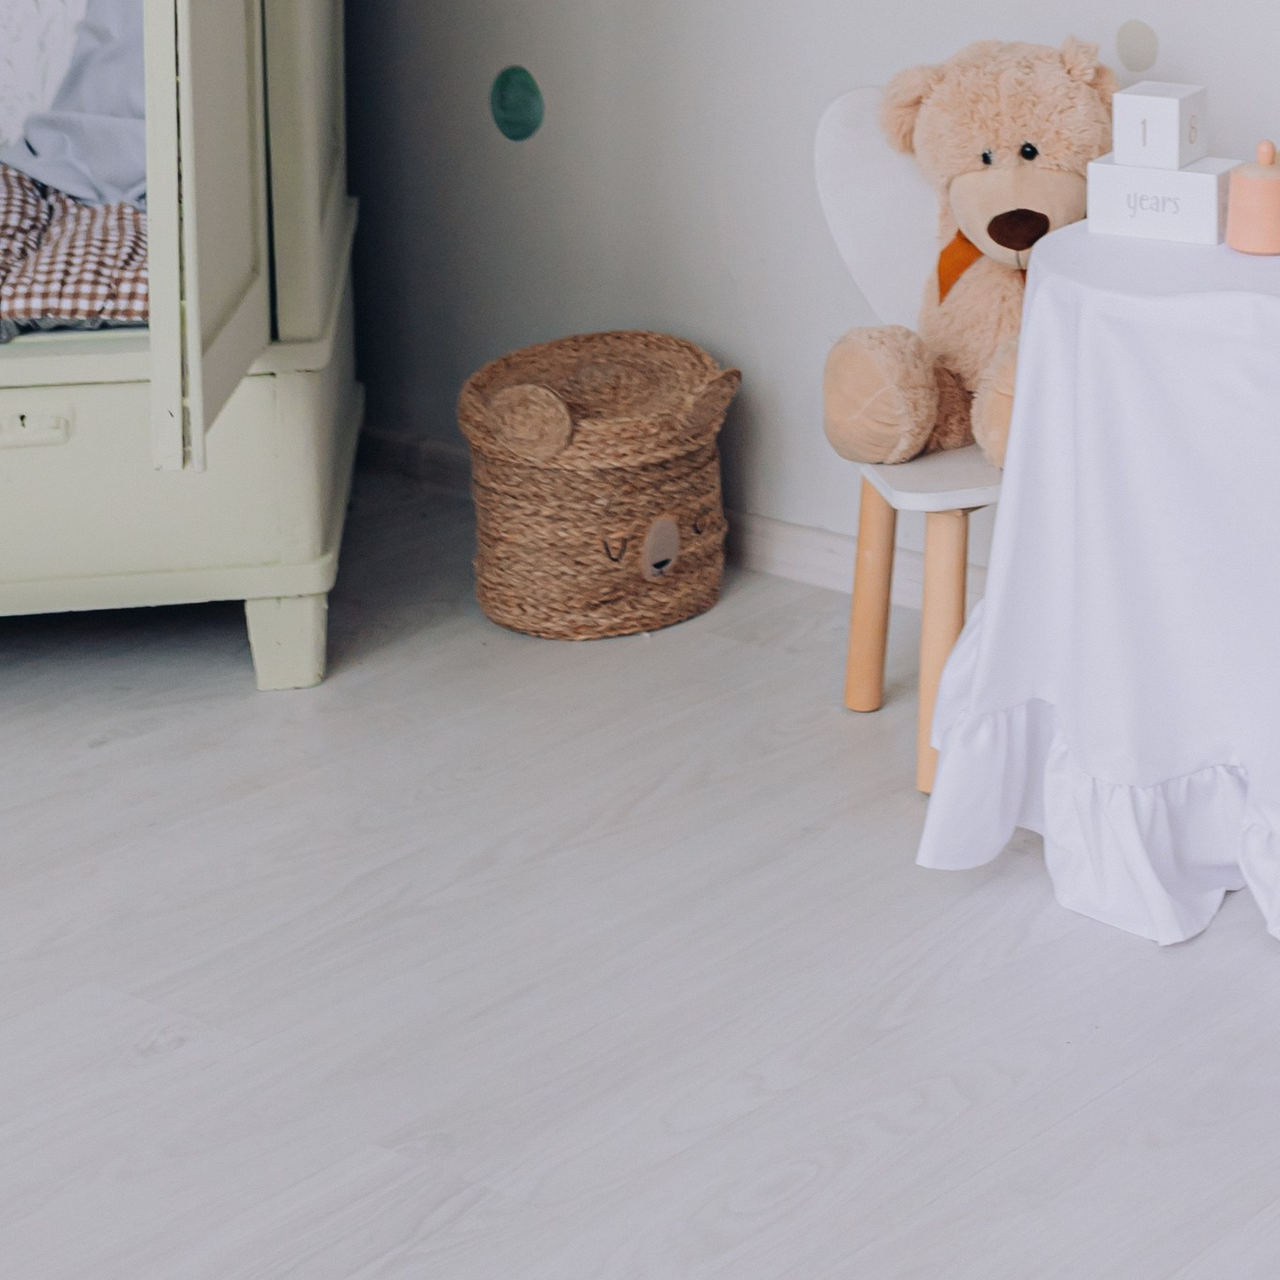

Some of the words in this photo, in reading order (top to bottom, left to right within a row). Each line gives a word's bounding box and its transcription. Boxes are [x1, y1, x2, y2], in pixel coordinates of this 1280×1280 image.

[1139, 118, 1148, 147] 1
[1187, 114, 1199, 145] 6
[1126, 191, 1181, 219] years
